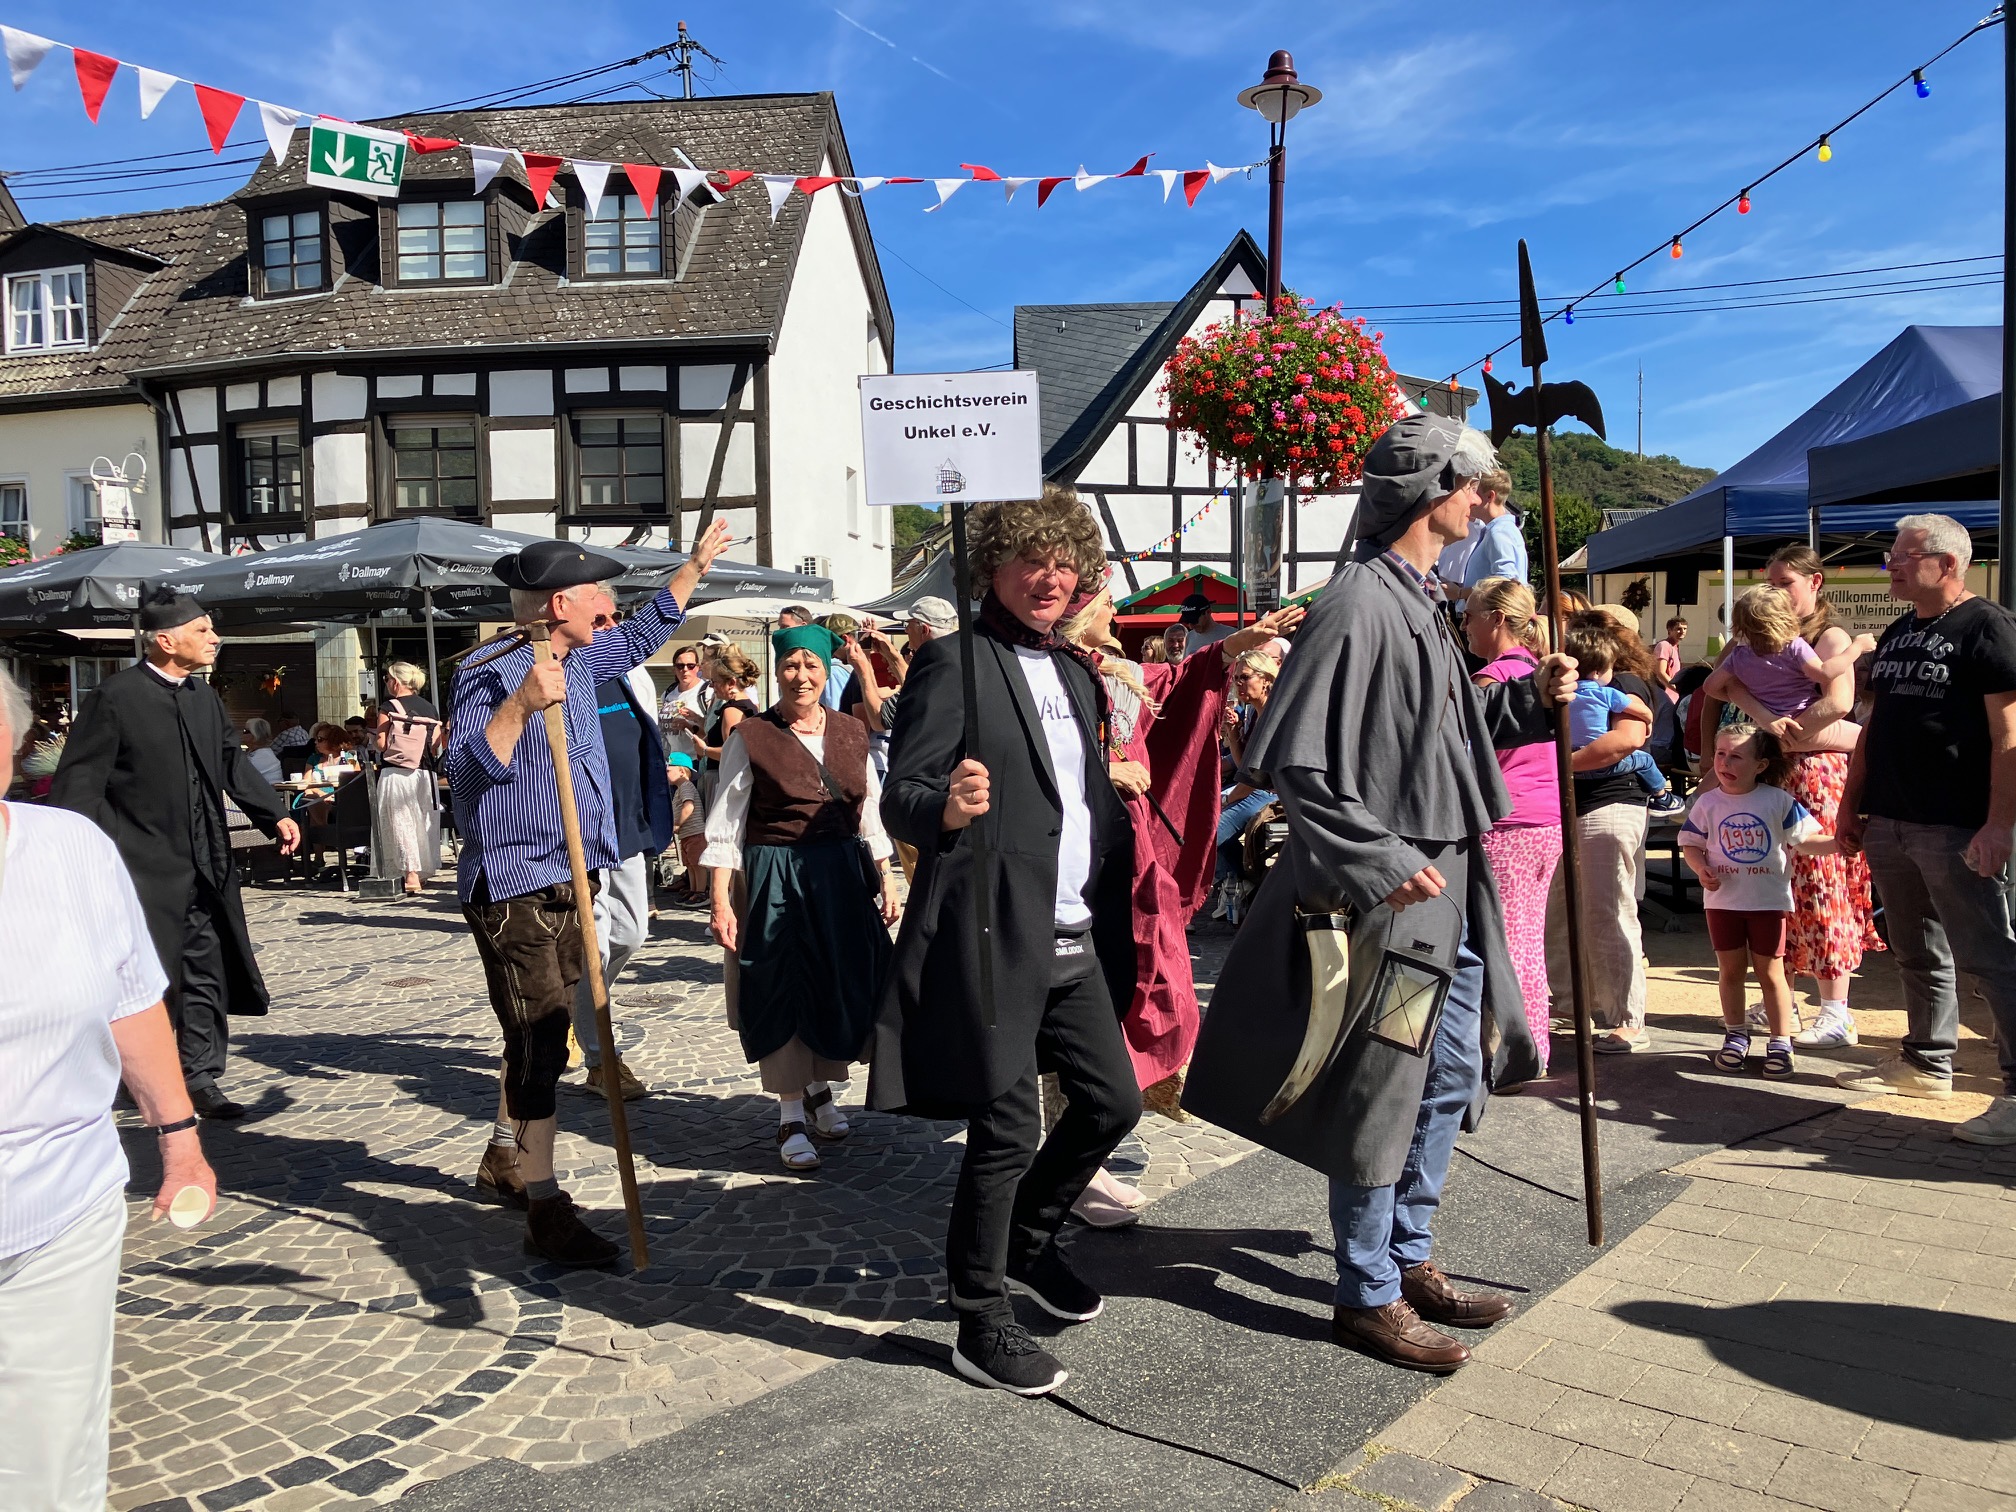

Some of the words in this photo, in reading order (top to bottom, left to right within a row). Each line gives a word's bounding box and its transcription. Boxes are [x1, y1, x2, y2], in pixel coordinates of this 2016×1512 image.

[870, 392, 1028, 411] Geschichtsverein
[904, 424, 956, 440] Unkel
[962, 423, 997, 437] e.V.
[352, 566, 391, 579] Dallmayr
[450, 563, 493, 575] Dallmayr
[256, 574, 295, 587] Dallmayr
[742, 583, 767, 593] Dallmayr
[37, 589, 73, 602] Dallmayr
[1853, 622, 1867, 630] bis
[1722, 829, 1764, 850] 1994
[1717, 865, 1740, 875] NEW
